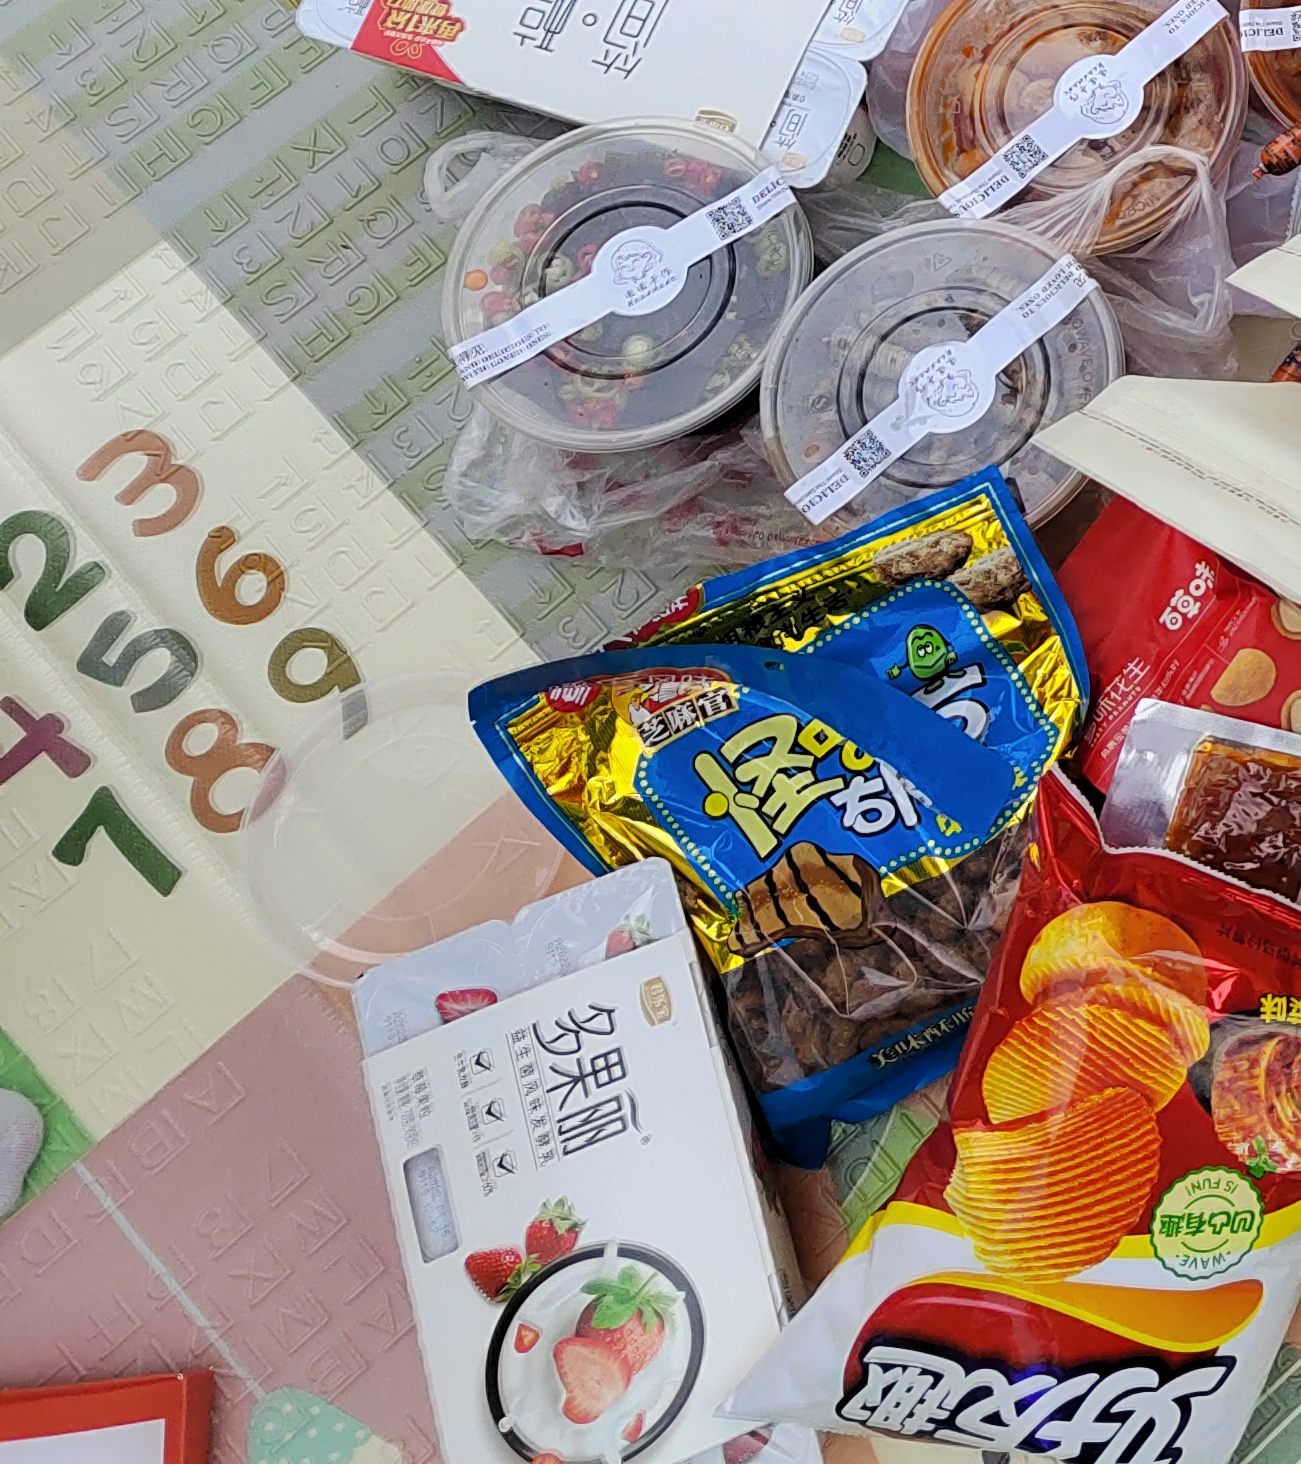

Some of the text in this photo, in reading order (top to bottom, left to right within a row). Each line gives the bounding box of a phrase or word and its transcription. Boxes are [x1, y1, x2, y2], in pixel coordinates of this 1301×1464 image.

[1158, 561, 1218, 632] 百草味
[636, 689, 739, 747] 芝麻官
[509, 1027, 555, 1169] 益生菌风味发酵乳
[546, 1001, 645, 1156] 多果丽
[1180, 1176, 1234, 1199] IS FUN!
[1157, 1207, 1256, 1242] 凹凸有趣
[1180, 1250, 1234, 1278] WAVE
[845, 1344, 1235, 1464] 好友趣
